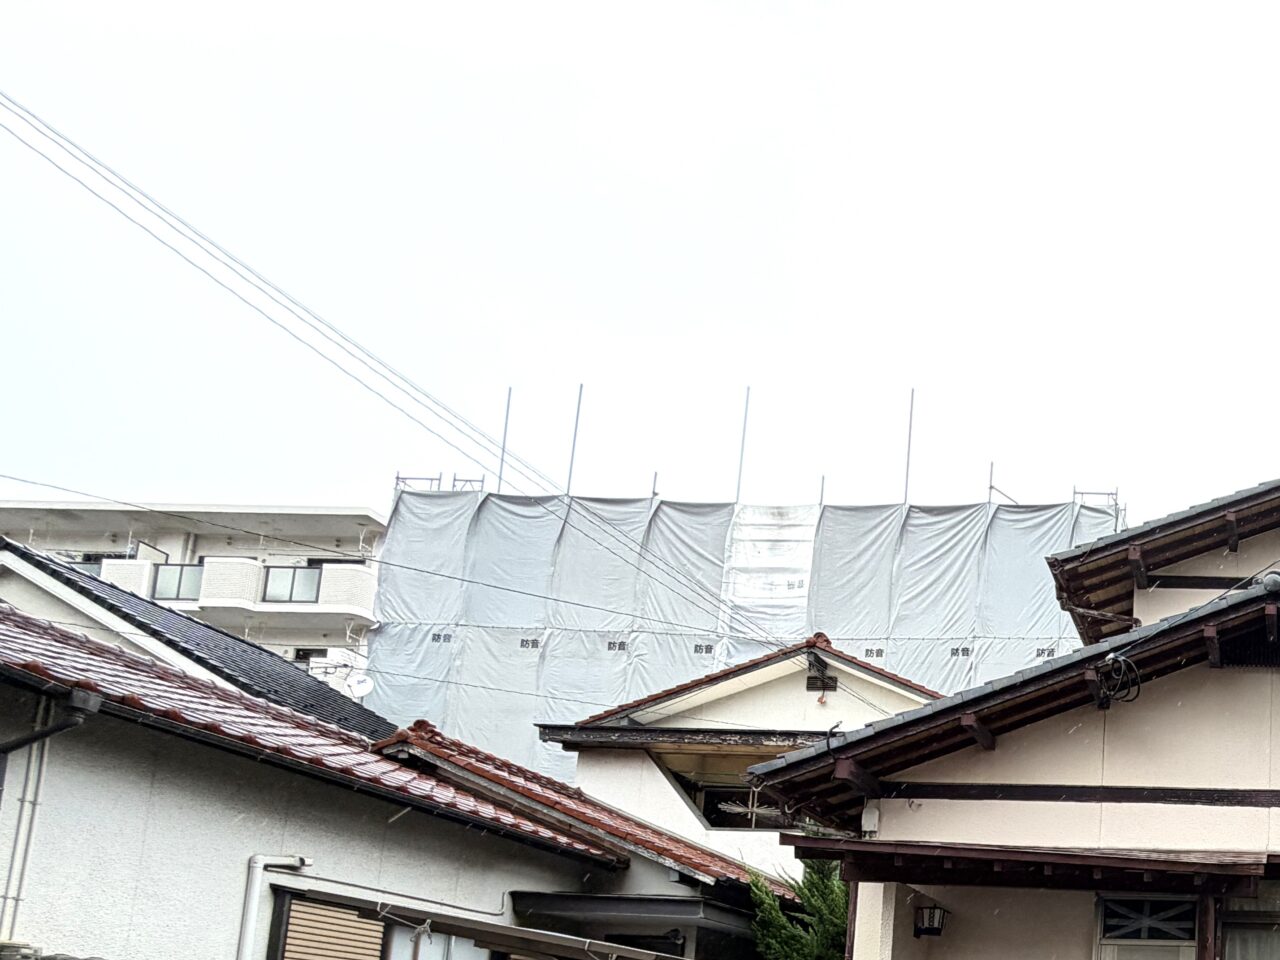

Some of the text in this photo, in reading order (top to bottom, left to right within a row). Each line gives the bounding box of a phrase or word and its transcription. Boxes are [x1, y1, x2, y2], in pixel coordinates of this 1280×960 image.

[520, 639, 539, 649] 防音
[608, 641, 627, 651] 防音
[694, 644, 714, 654] 防音
[865, 648, 884, 658] 防音
[950, 647, 970, 657] 防音
